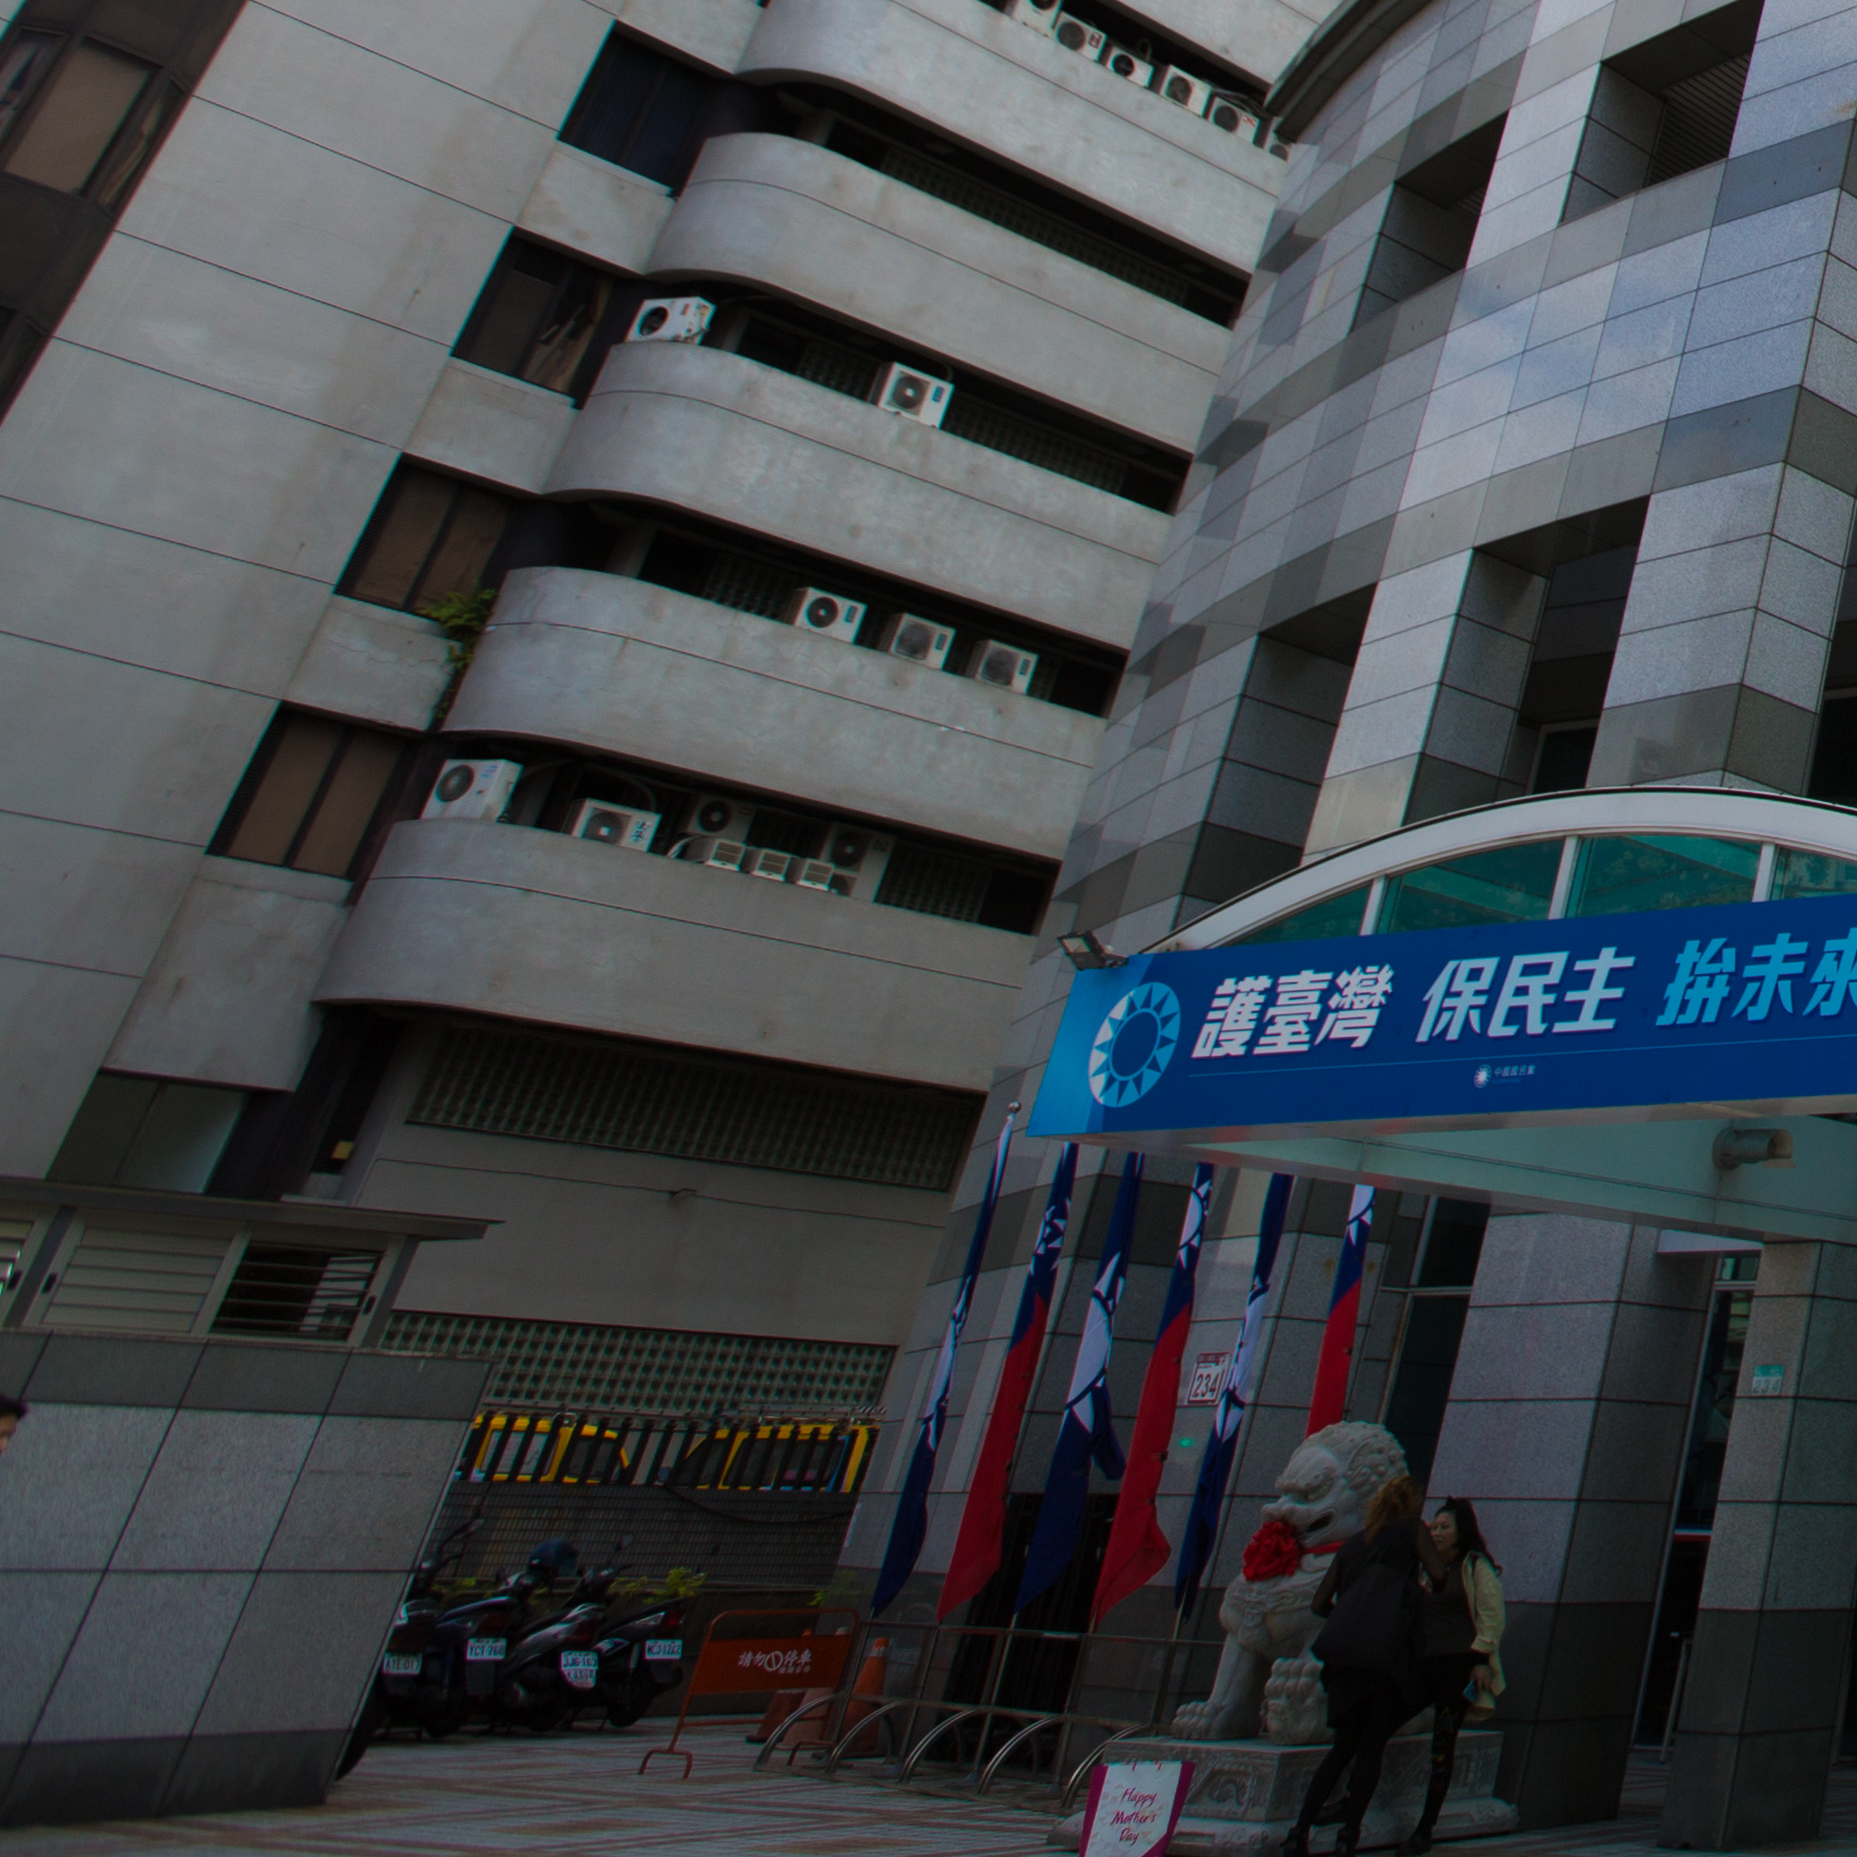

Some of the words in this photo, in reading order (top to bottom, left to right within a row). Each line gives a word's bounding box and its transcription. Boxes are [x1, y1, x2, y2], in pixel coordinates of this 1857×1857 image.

[1191, 964, 1394, 1058] 護臺灣
[1415, 947, 1635, 1043] 保民主
[1193, 1372, 1219, 1397] 234
[1752, 1378, 1780, 1394] 234
[1121, 1787, 1157, 1808] Happy
[1119, 1827, 1139, 1846] Day
